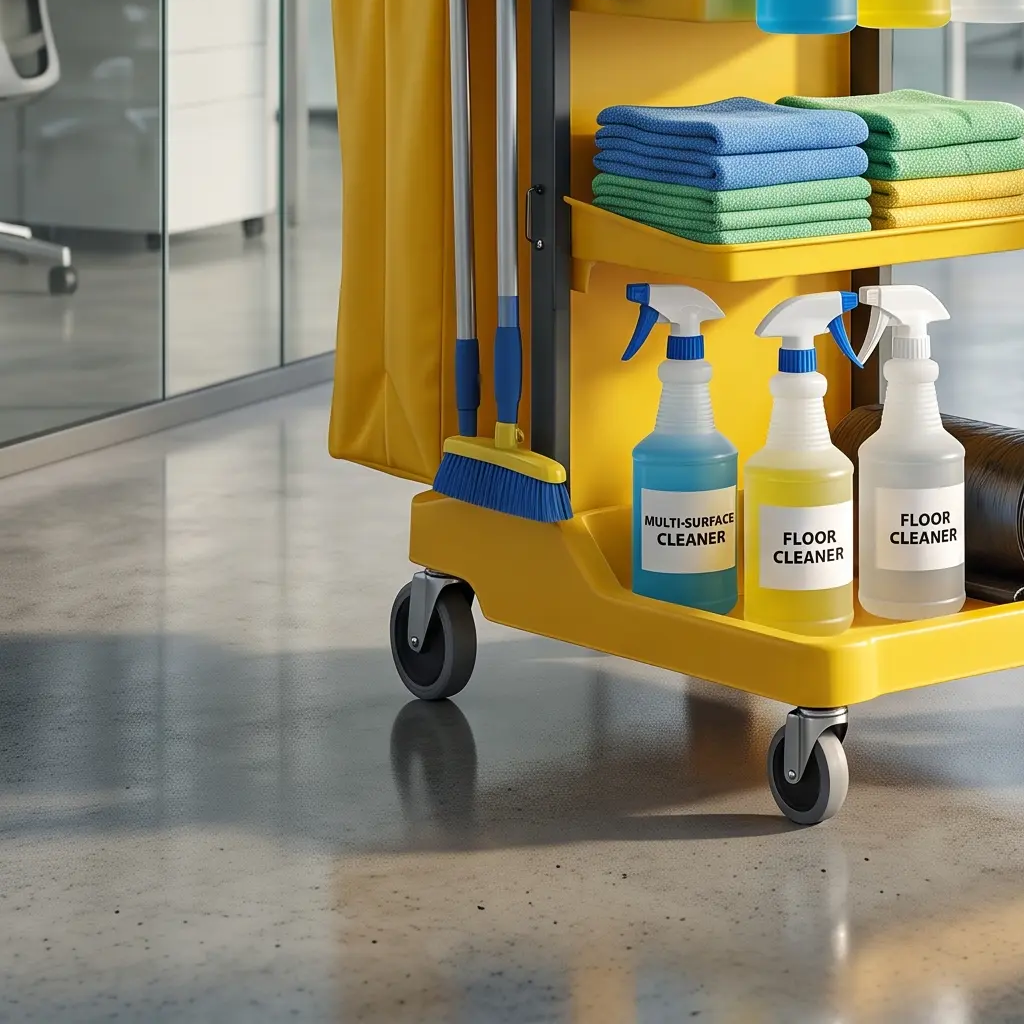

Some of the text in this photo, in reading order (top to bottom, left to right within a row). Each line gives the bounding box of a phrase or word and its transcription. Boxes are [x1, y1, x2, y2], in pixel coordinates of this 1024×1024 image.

[644, 512, 735, 529] MULTI-SURFACE
[900, 511, 951, 527] FLOOR
[657, 530, 726, 547] CLEANER
[783, 530, 837, 546] FLOOR
[889, 528, 958, 545] CLEANER
[773, 547, 844, 564] CLEANER
